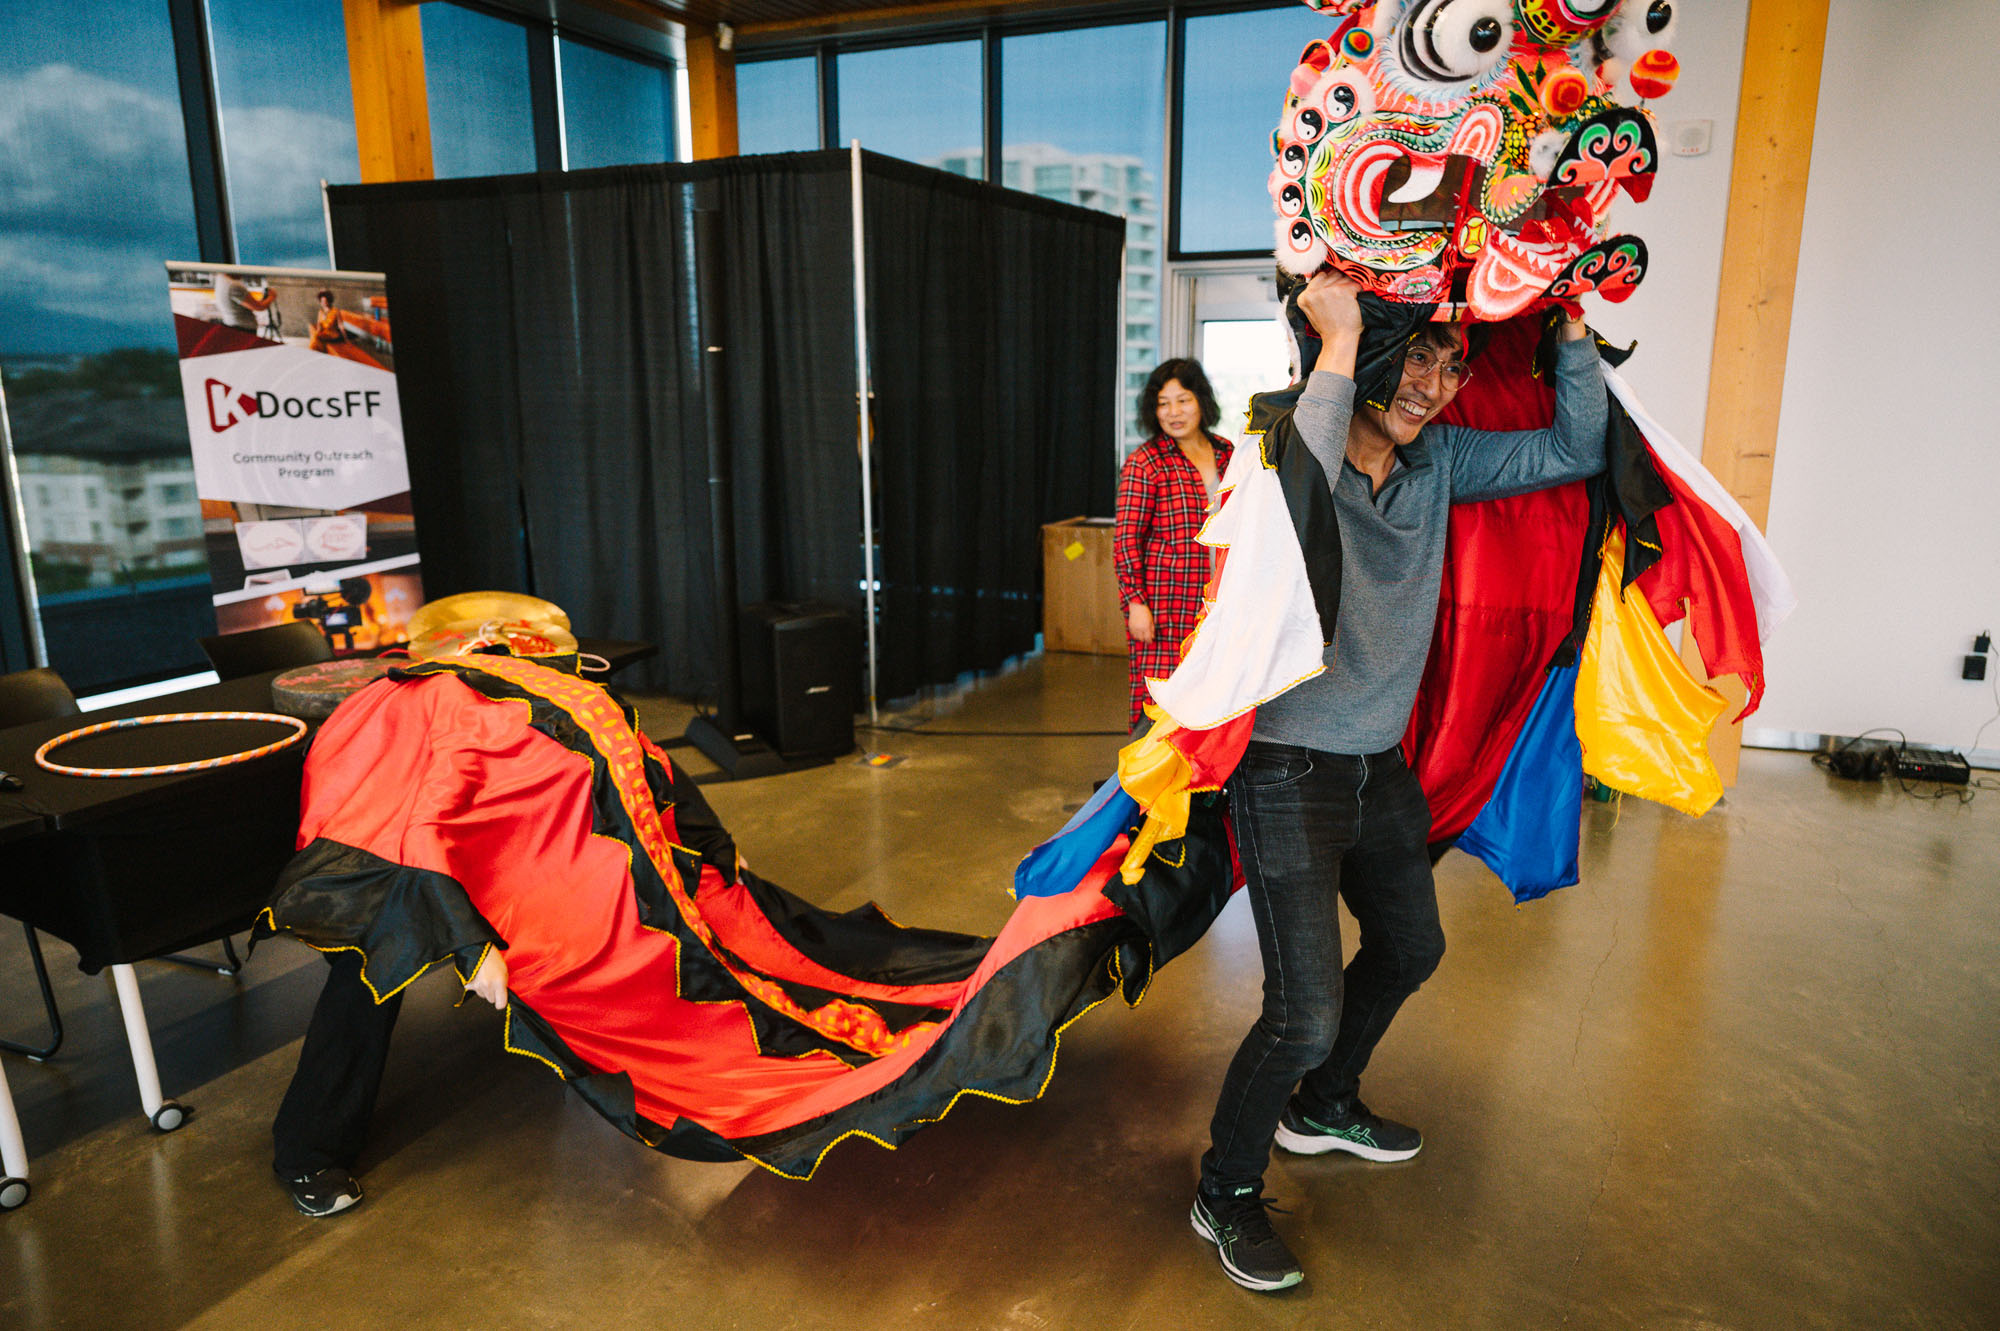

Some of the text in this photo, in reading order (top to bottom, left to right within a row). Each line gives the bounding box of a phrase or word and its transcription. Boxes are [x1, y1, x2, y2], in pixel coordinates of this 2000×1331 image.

[233, 450, 373, 465] Community Outreach
[278, 467, 335, 479] Program
